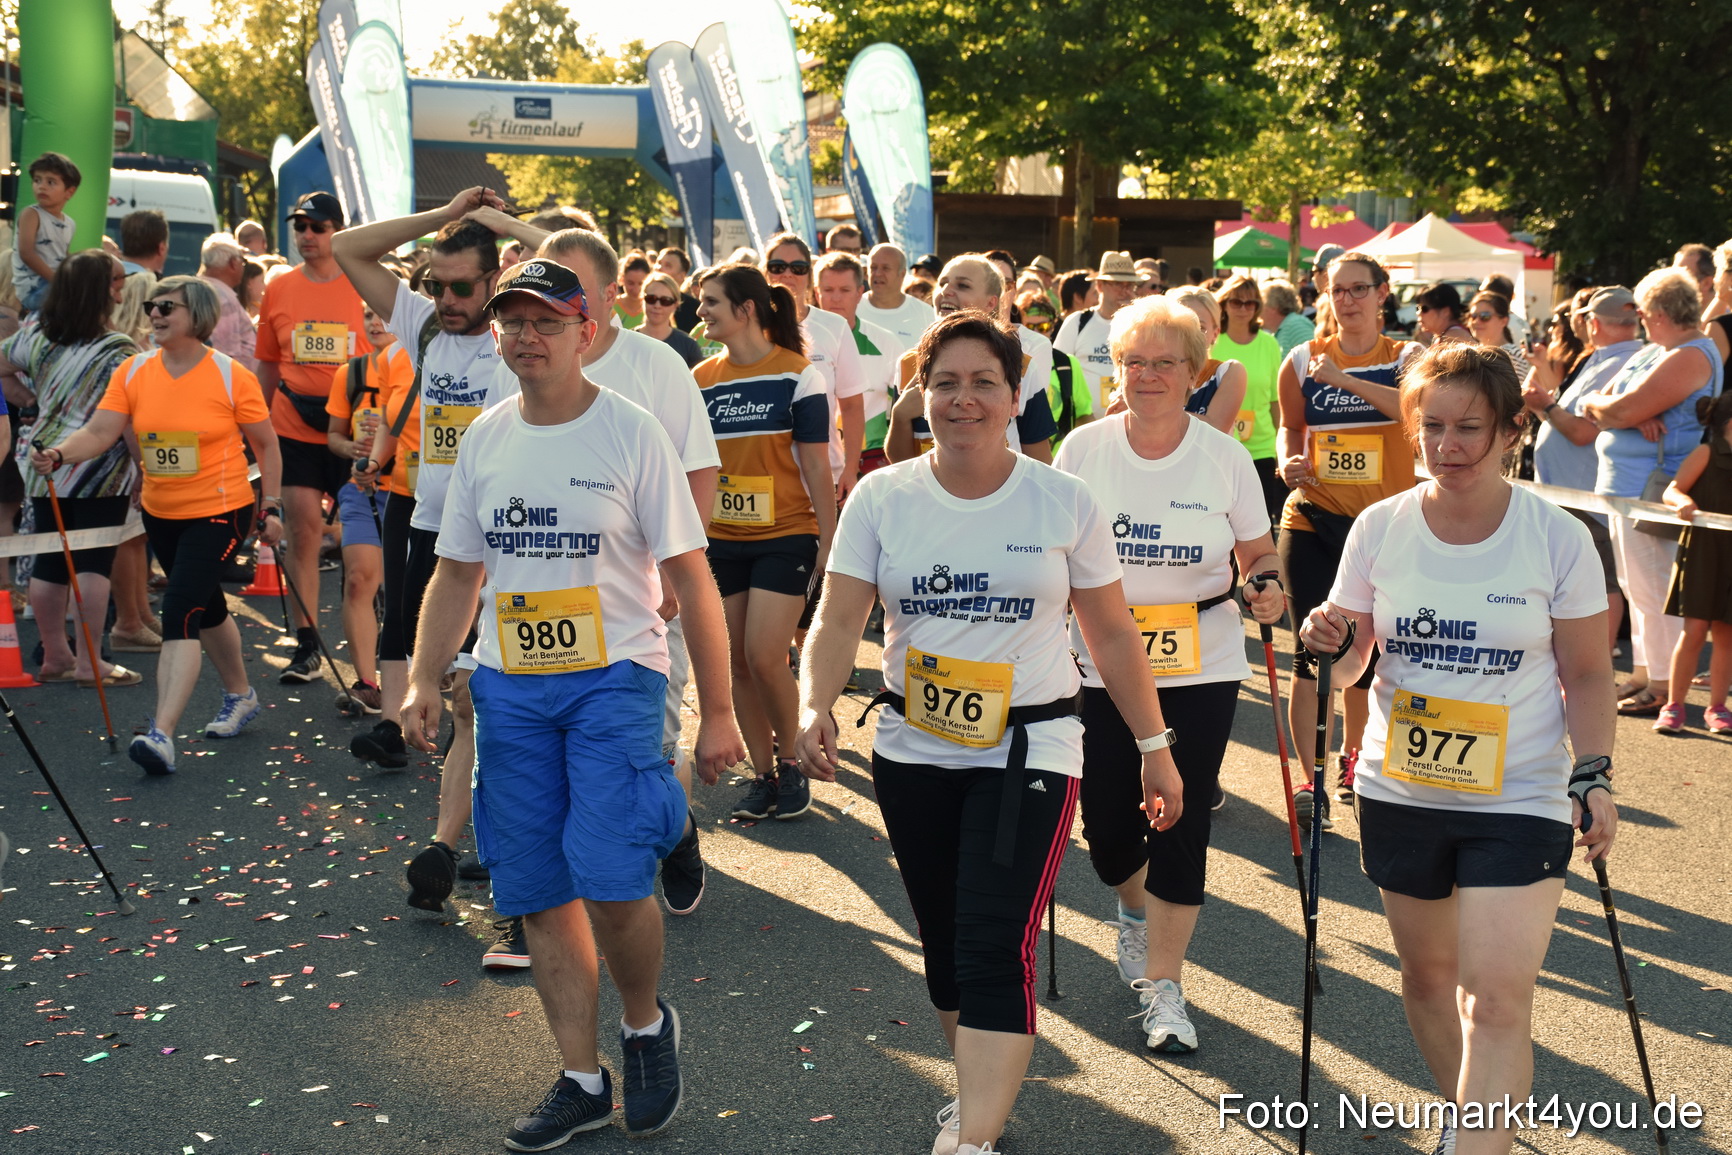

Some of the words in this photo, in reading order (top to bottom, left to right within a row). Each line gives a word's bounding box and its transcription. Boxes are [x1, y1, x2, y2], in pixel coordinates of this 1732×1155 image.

[500, 119, 584, 138] firmenlauf
[511, 277, 553, 288] VOLKSWAGEN
[305, 336, 335, 351] 888
[1324, 393, 1366, 406] Fisc
[715, 401, 774, 416] Fischer
[720, 413, 768, 423] AUTOMOBILE
[433, 427, 468, 448] 98
[156, 448, 179, 465] 96
[1328, 452, 1366, 470] 588
[570, 477, 615, 492] Benjamin
[721, 492, 755, 512] 601
[1170, 500, 1208, 511] Roswitha
[1112, 513, 1162, 540] ÖNIG
[528, 550, 543, 558] build
[545, 551, 564, 559] your
[1006, 544, 1043, 553] Kerstin
[1116, 542, 1203, 563] ineering
[912, 564, 989, 596] KÖNIG
[1486, 593, 1527, 605] Corinna
[899, 595, 1036, 621] Engineering
[950, 611, 969, 621] build
[970, 613, 992, 623] your
[993, 614, 1017, 624] tools
[1395, 607, 1477, 641] KÖNIG
[517, 619, 577, 651] 980
[1141, 630, 1178, 656] 75
[518, 660, 534, 668] König
[534, 658, 567, 667] Engineering
[567, 656, 586, 664] GmbH
[523, 652, 538, 660] Karl
[540, 649, 579, 660] Benjamin
[1149, 656, 1178, 664] oswitha
[1386, 637, 1525, 672] Engineering
[916, 662, 951, 678] firmenlauf
[1422, 661, 1434, 670] we
[1436, 663, 1455, 672] build
[1457, 665, 1480, 675] your
[1483, 667, 1506, 675] tools
[923, 683, 984, 723] 976
[1403, 705, 1441, 720] firmenlauf
[920, 717, 934, 728] König
[934, 724, 965, 738] Engineering
[965, 731, 985, 740] GmbH
[925, 711, 947, 726] König
[948, 719, 979, 732] Kerstin
[1407, 726, 1478, 765] 977
[1400, 766, 1418, 776] König
[1418, 771, 1456, 783] Engineering
[1457, 776, 1478, 785] GmbH
[1407, 758, 1432, 771] Ferstl
[1435, 764, 1472, 777] Corinna
